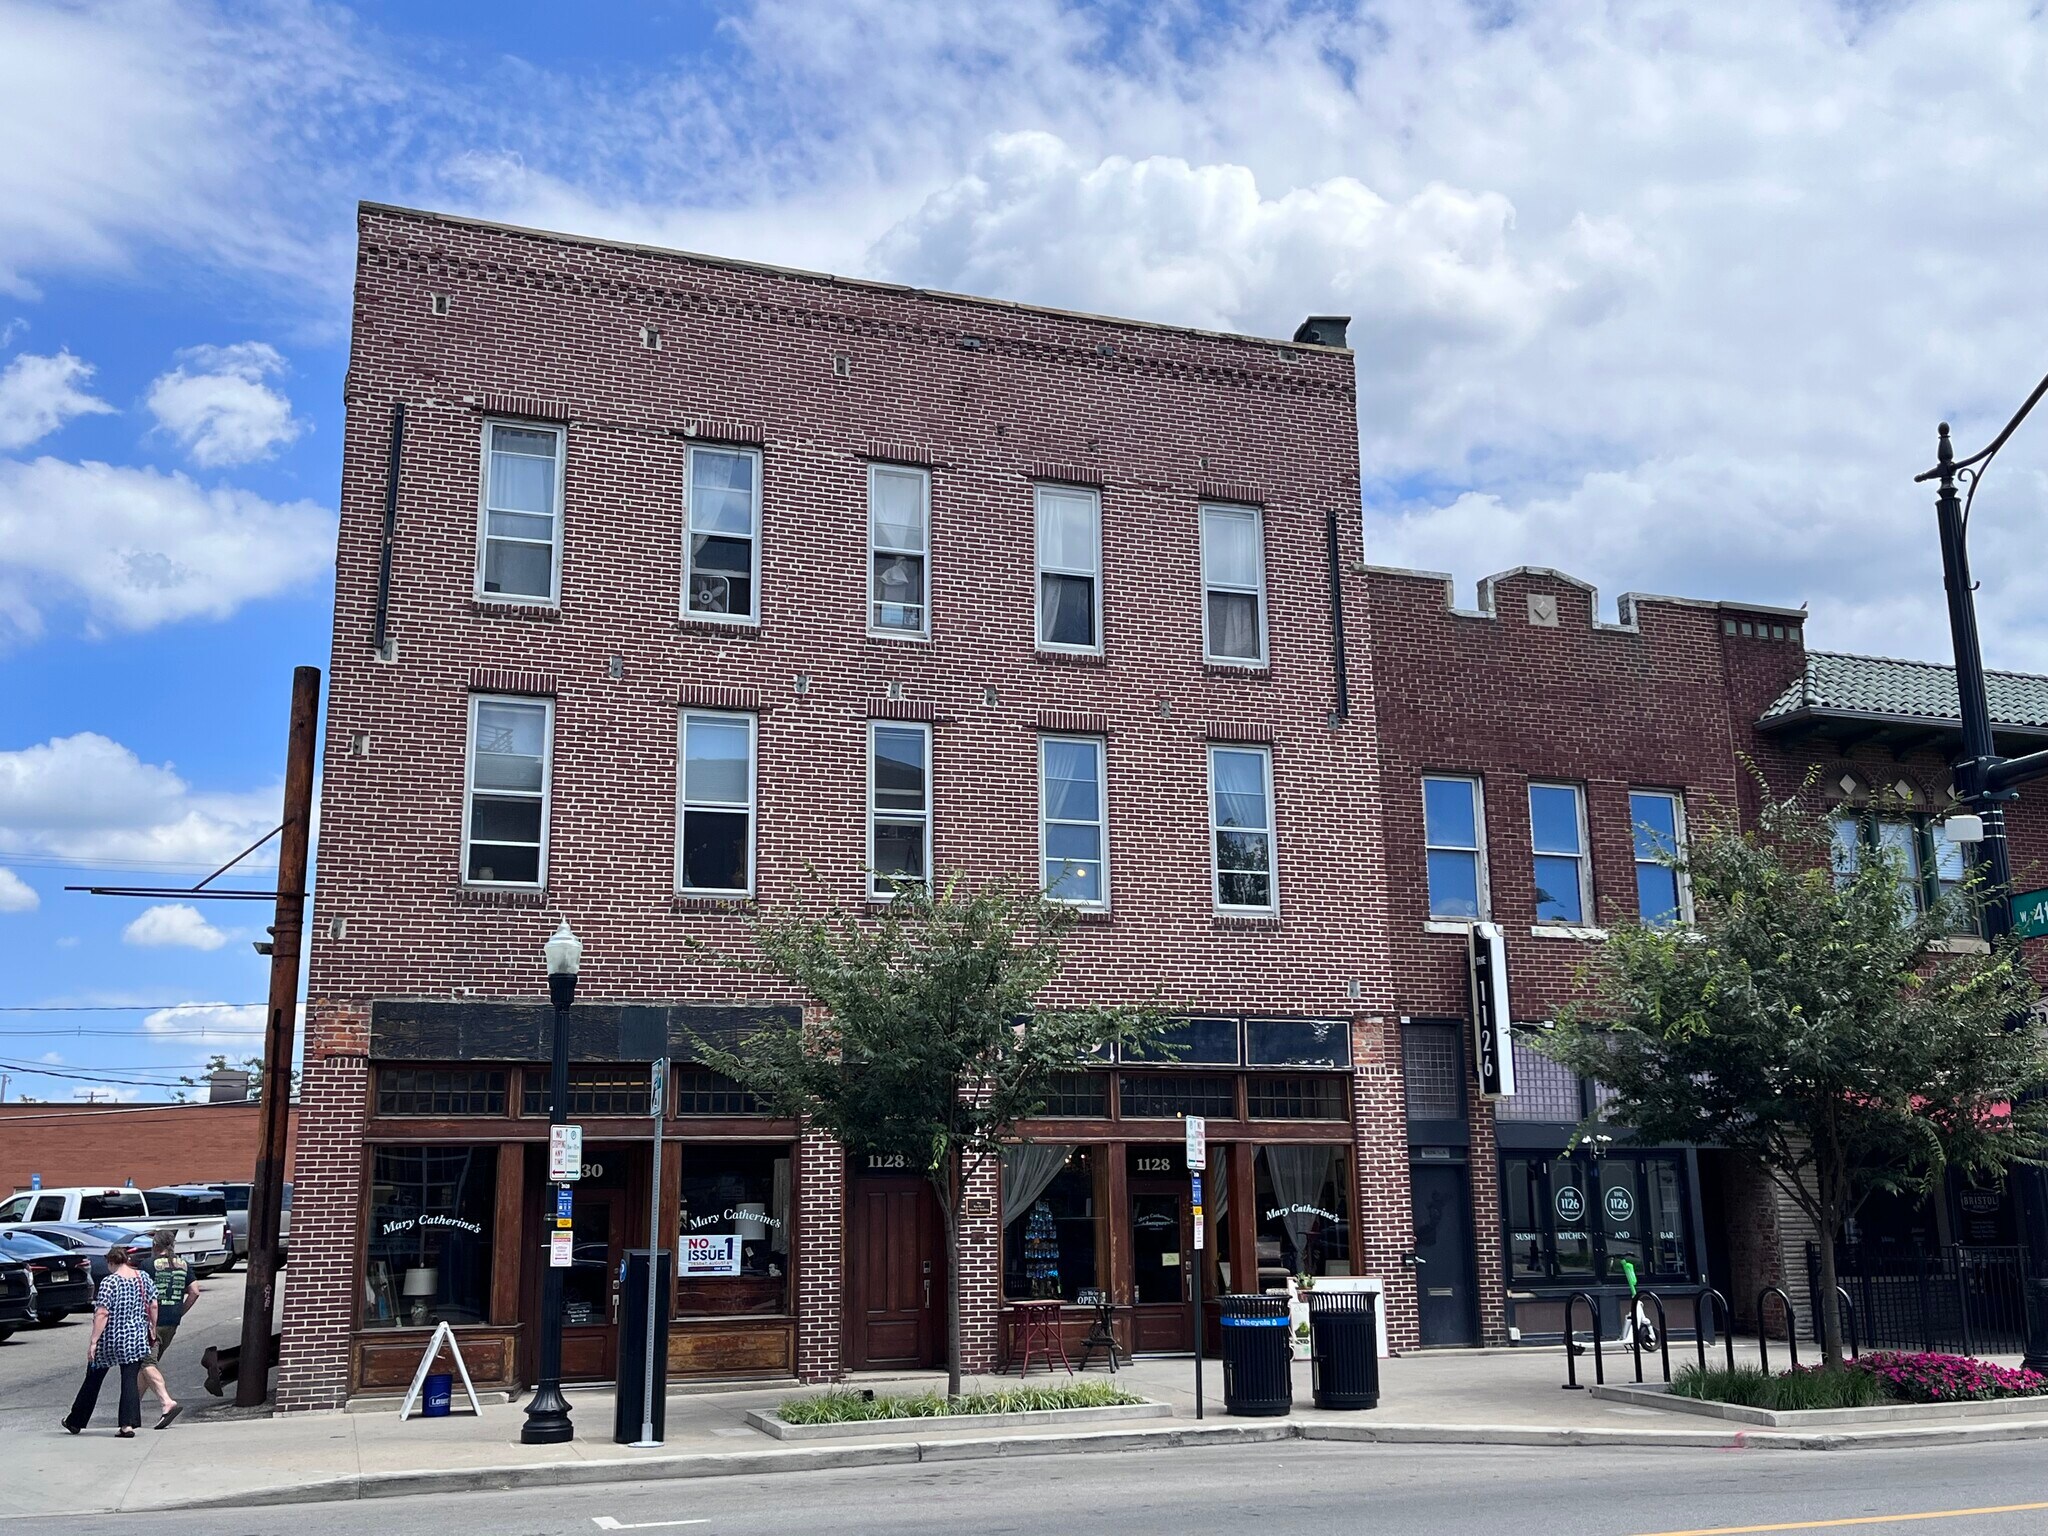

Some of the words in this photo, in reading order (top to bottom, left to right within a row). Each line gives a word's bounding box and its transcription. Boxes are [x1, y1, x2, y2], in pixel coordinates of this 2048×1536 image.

[2020, 911, 2027, 922] W
[1476, 956, 1486, 966] THE
[1480, 980, 1493, 1077] 1126
[1137, 1158, 1171, 1171] 1128
[1561, 1198, 1580, 1209] 1126
[1610, 1198, 1629, 1209] 1126
[1963, 1196, 1997, 1205] BRISTOL
[1266, 1207, 1290, 1221] Mary
[1291, 1203, 1340, 1223] Catherine's
[383, 1219, 415, 1235] Mary
[418, 1214, 482, 1233] Catherine's
[690, 1214, 720, 1230] Mary
[723, 1209, 782, 1228] Catherine's
[1557, 1232, 1587, 1240] KITCHEN
[1614, 1231, 1630, 1239] AND
[688, 1238, 710, 1249] NO
[688, 1249, 726, 1261] ISSUE
[724, 1237, 734, 1260] 1
[1077, 1296, 1098, 1304] OPEN
[1240, 1319, 1271, 1327] Recycle
